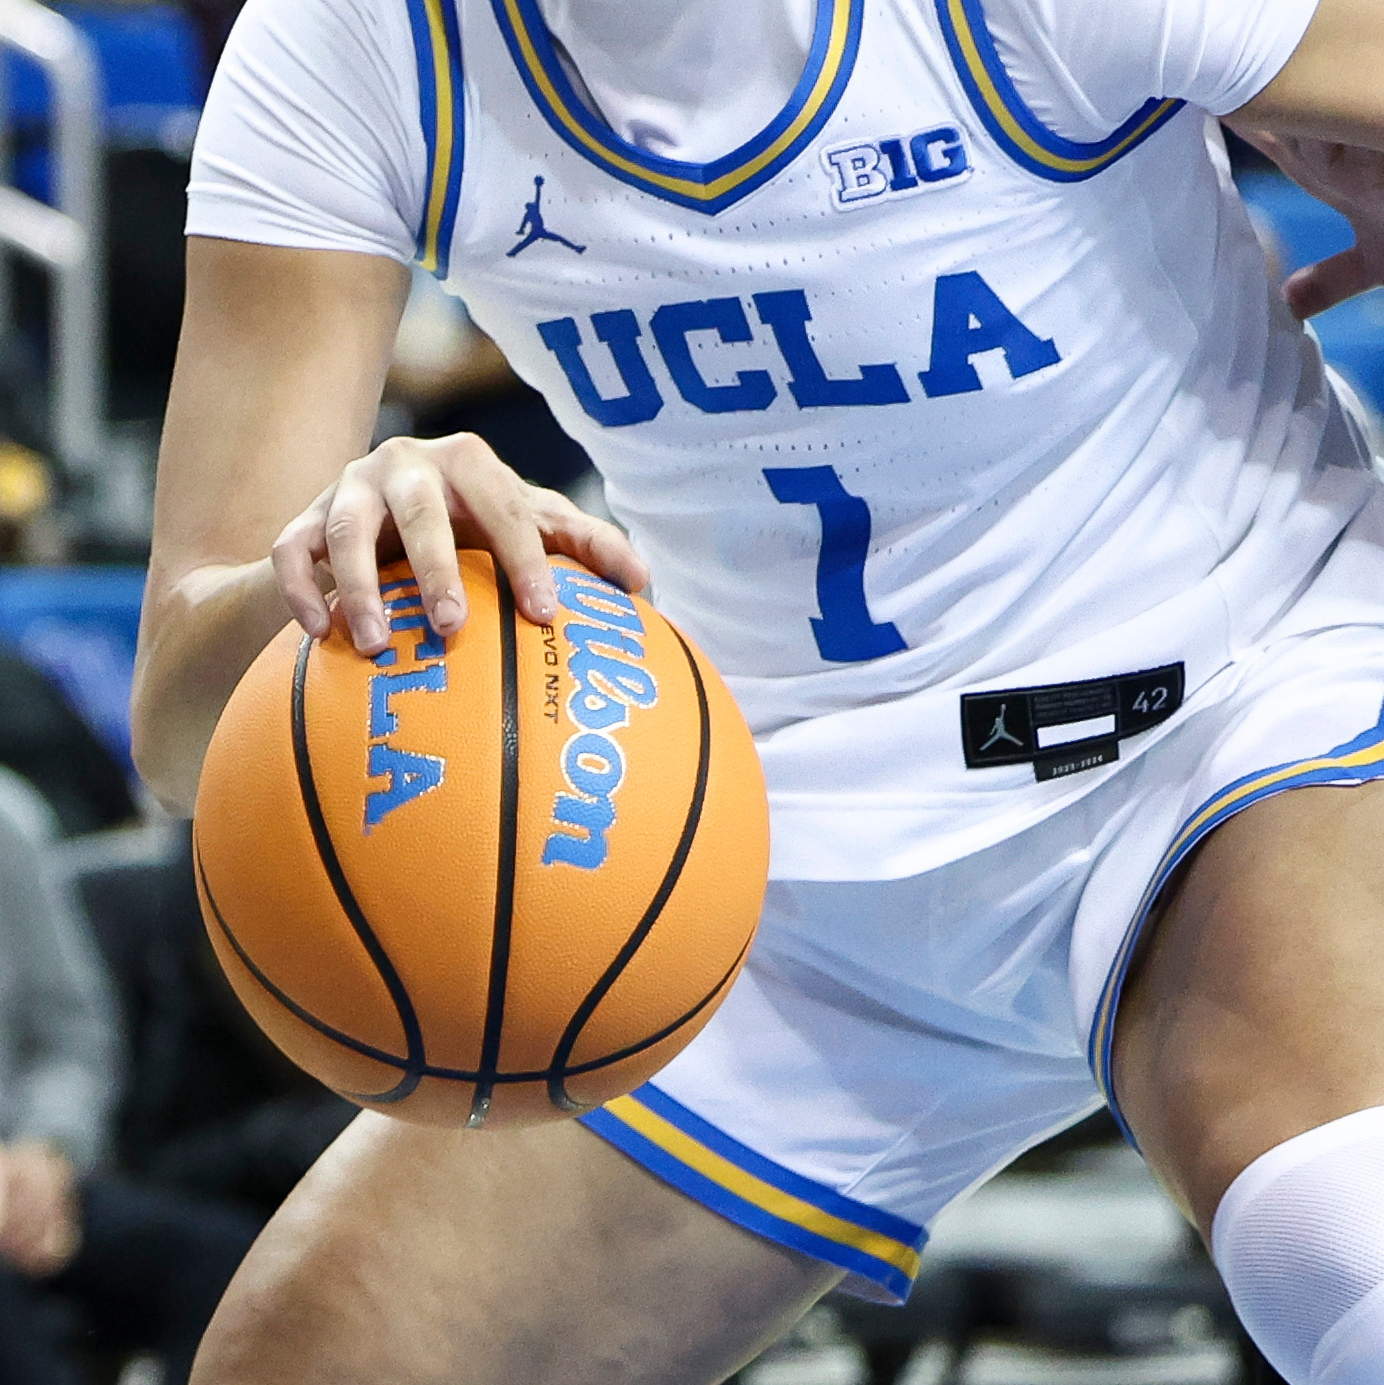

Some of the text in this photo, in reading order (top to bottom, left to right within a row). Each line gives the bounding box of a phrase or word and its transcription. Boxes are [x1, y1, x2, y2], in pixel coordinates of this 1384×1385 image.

[536, 271, 1061, 427] UCLA
[762, 464, 909, 662] 1
[540, 624, 559, 724] EVO NXT
[541, 566, 658, 871] Wilson
[1132, 686, 1168, 713] 42
